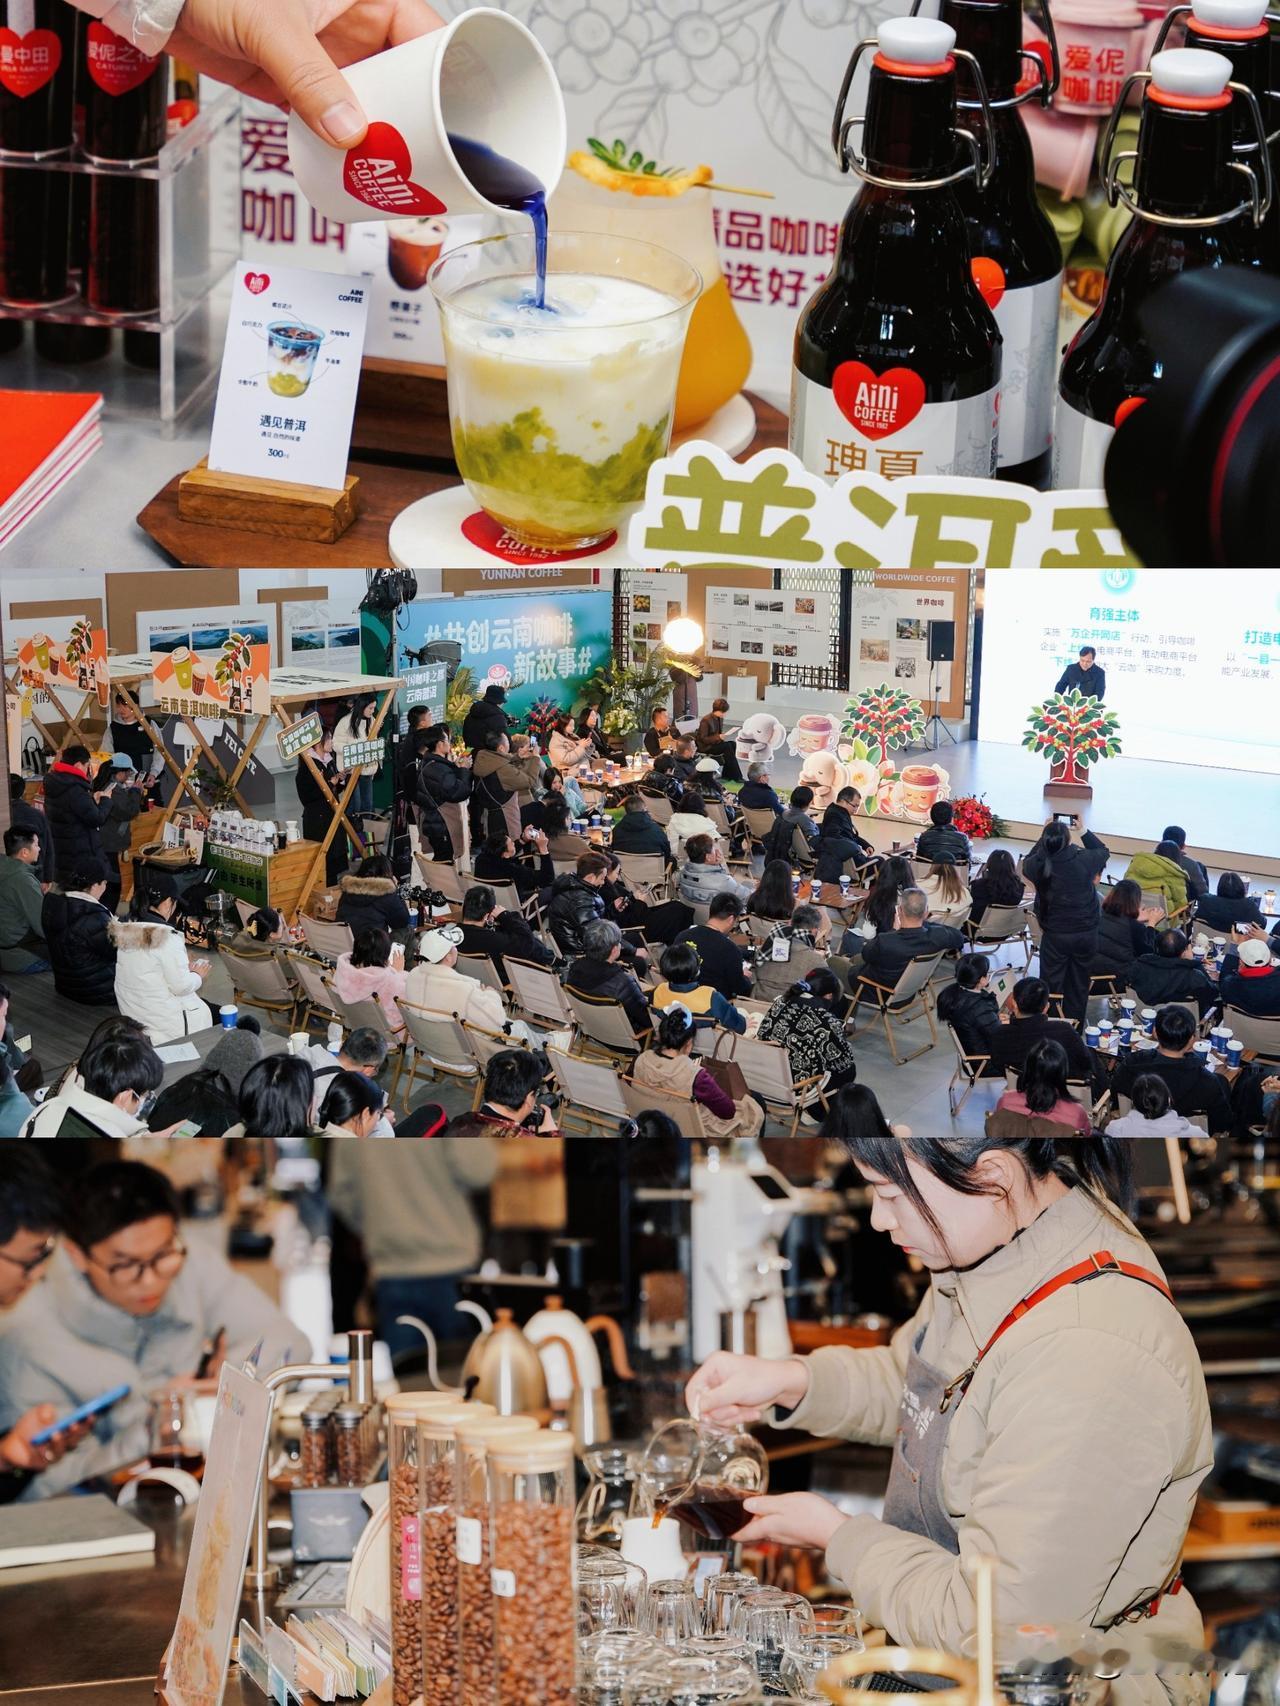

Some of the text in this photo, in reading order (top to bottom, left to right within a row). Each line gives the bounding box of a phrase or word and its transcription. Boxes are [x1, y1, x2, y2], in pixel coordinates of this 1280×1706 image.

[353, 159, 394, 208] COFFEE
[713, 207, 839, 256] 品咖啡
[723, 260, 827, 308] 选好
[338, 294, 363, 304] COFFEE
[855, 382, 899, 410] Aini
[259, 415, 307, 432] 遇见普洱
[854, 405, 896, 423] COFFEE
[480, 568, 563, 580] YUNNAN COFFEE
[875, 573, 957, 583] WORLDWIDE COFFEE
[916, 598, 945, 607] 世界咖啡
[1089, 607, 1140, 622] 育强主体
[513, 646, 592, 684] 新故事#
[161, 697, 220, 719] 云南普洱咖啡
[343, 737, 385, 757] 云南普洱咖啡
